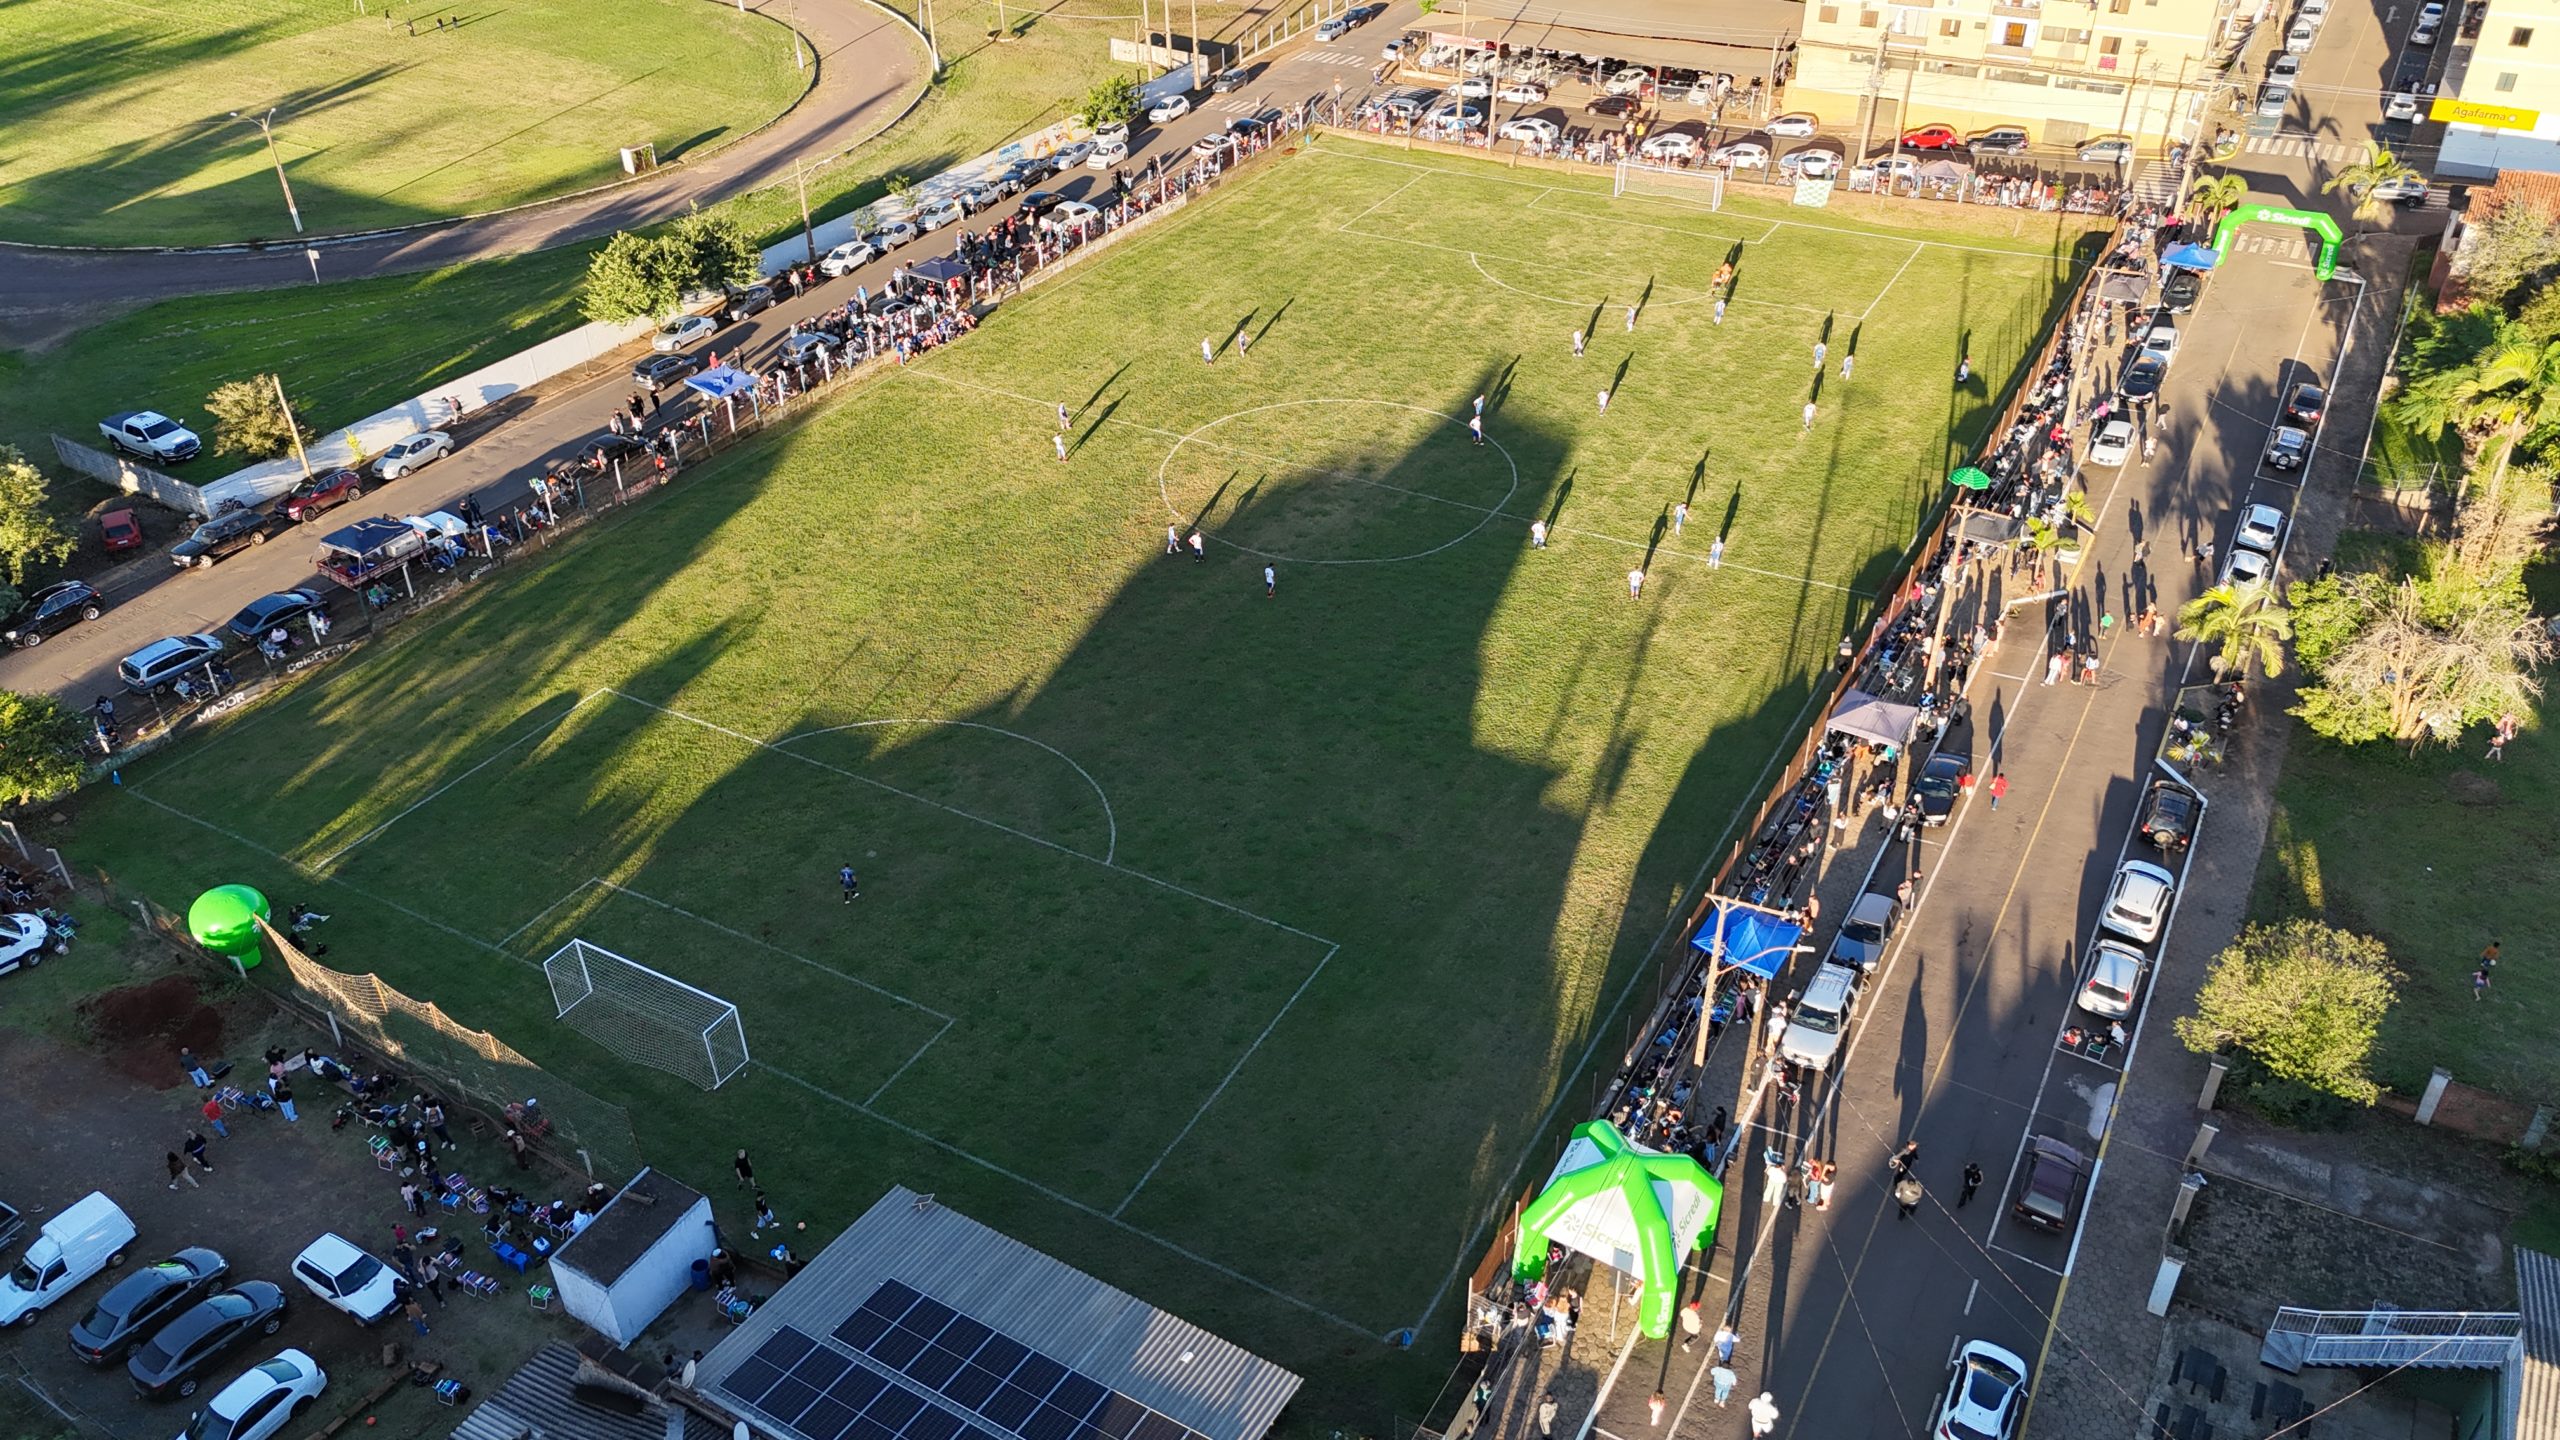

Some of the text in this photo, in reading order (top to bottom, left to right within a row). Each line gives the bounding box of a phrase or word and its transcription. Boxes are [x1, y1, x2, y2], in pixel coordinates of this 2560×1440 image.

[2452, 106, 2506, 121] Agafarma
[2271, 212, 2311, 225] Sicredi
[196, 691, 245, 723] MAJOR
[1678, 1192, 1701, 1237] Sicredi
[1582, 1223, 1637, 1257] Sicredi
